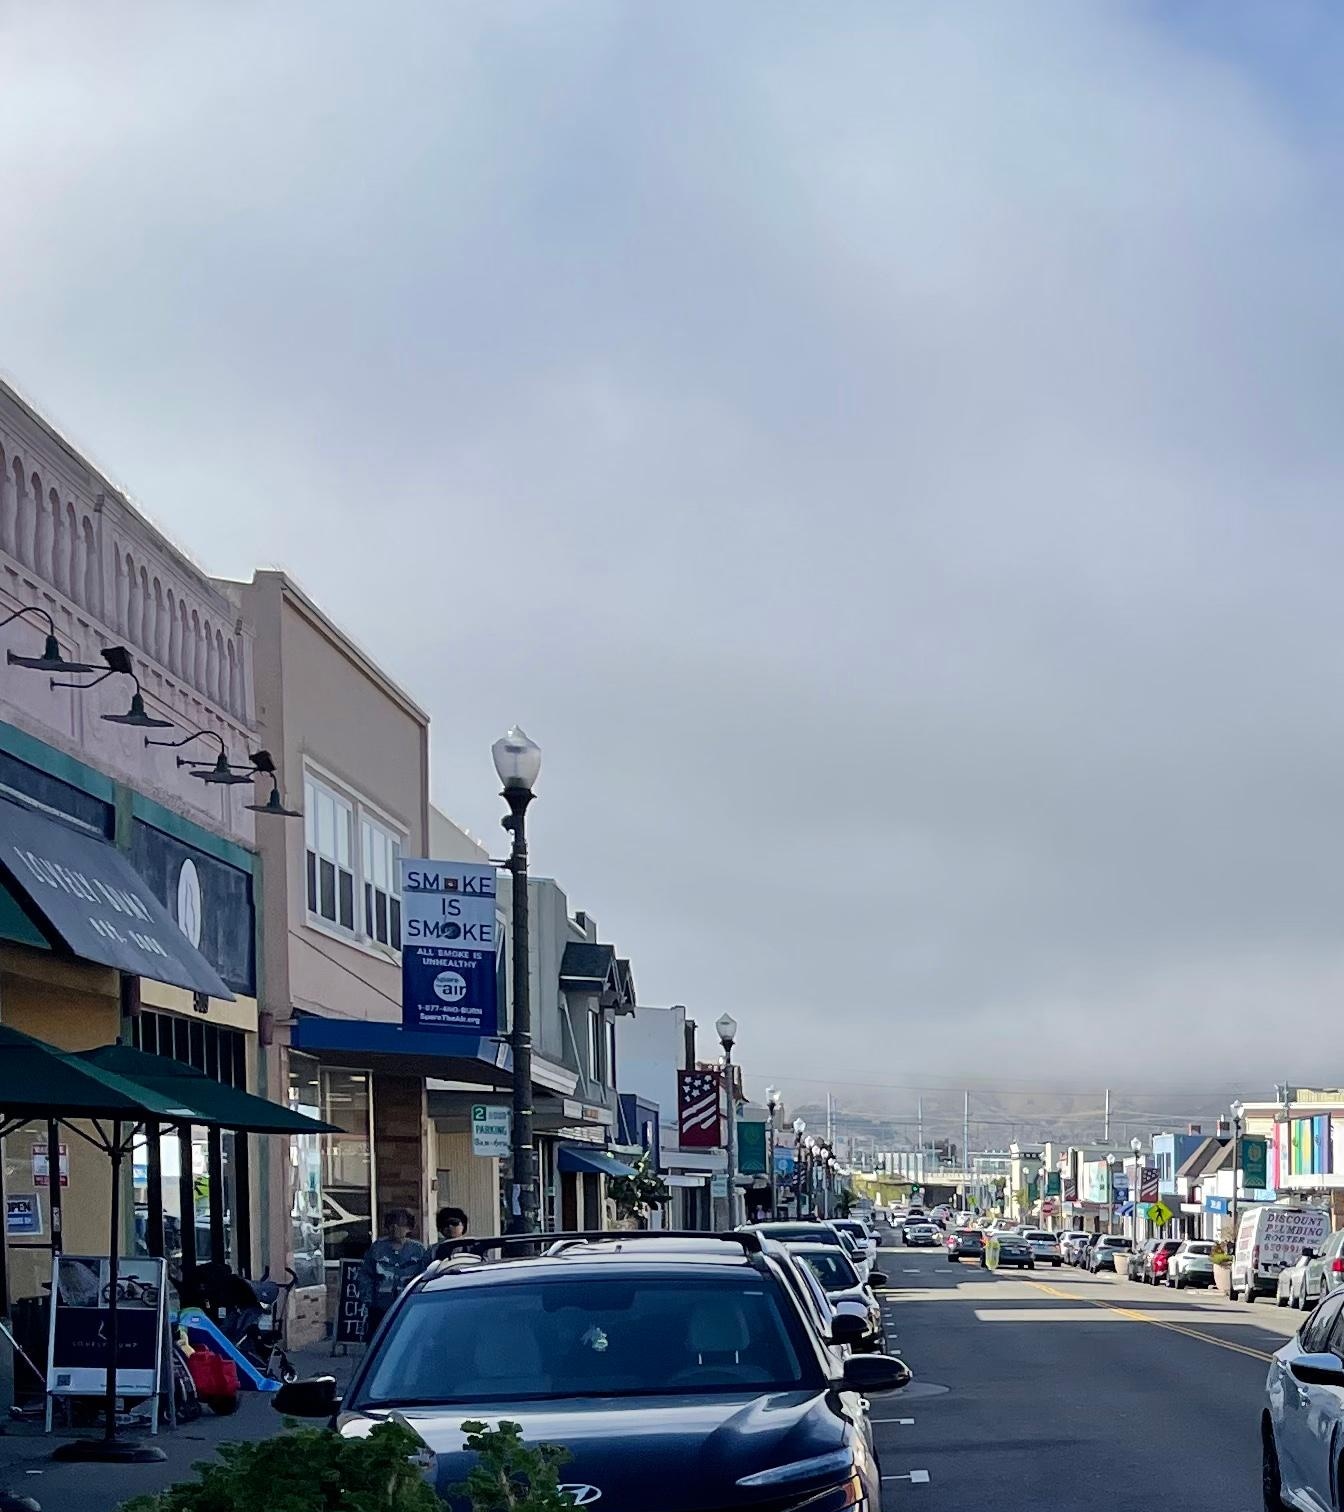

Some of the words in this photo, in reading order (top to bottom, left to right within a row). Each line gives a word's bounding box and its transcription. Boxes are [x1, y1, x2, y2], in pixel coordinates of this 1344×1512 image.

[13, 846, 102, 904] LOVELY
[441, 897, 462, 917] IS
[416, 947, 435, 957] ALL
[437, 949, 470, 959] SMOKE
[472, 951, 483, 960] IS
[422, 957, 478, 969] UNHEALTHY
[442, 984, 467, 996] air
[475, 1108, 484, 1119] 2
[475, 1124, 507, 1135] PARKING
[1266, 1213, 1324, 1227] DISCOUNT
[1265, 1223, 1324, 1237] PLUMBING
[1264, 1233, 1305, 1244] ROOTER
